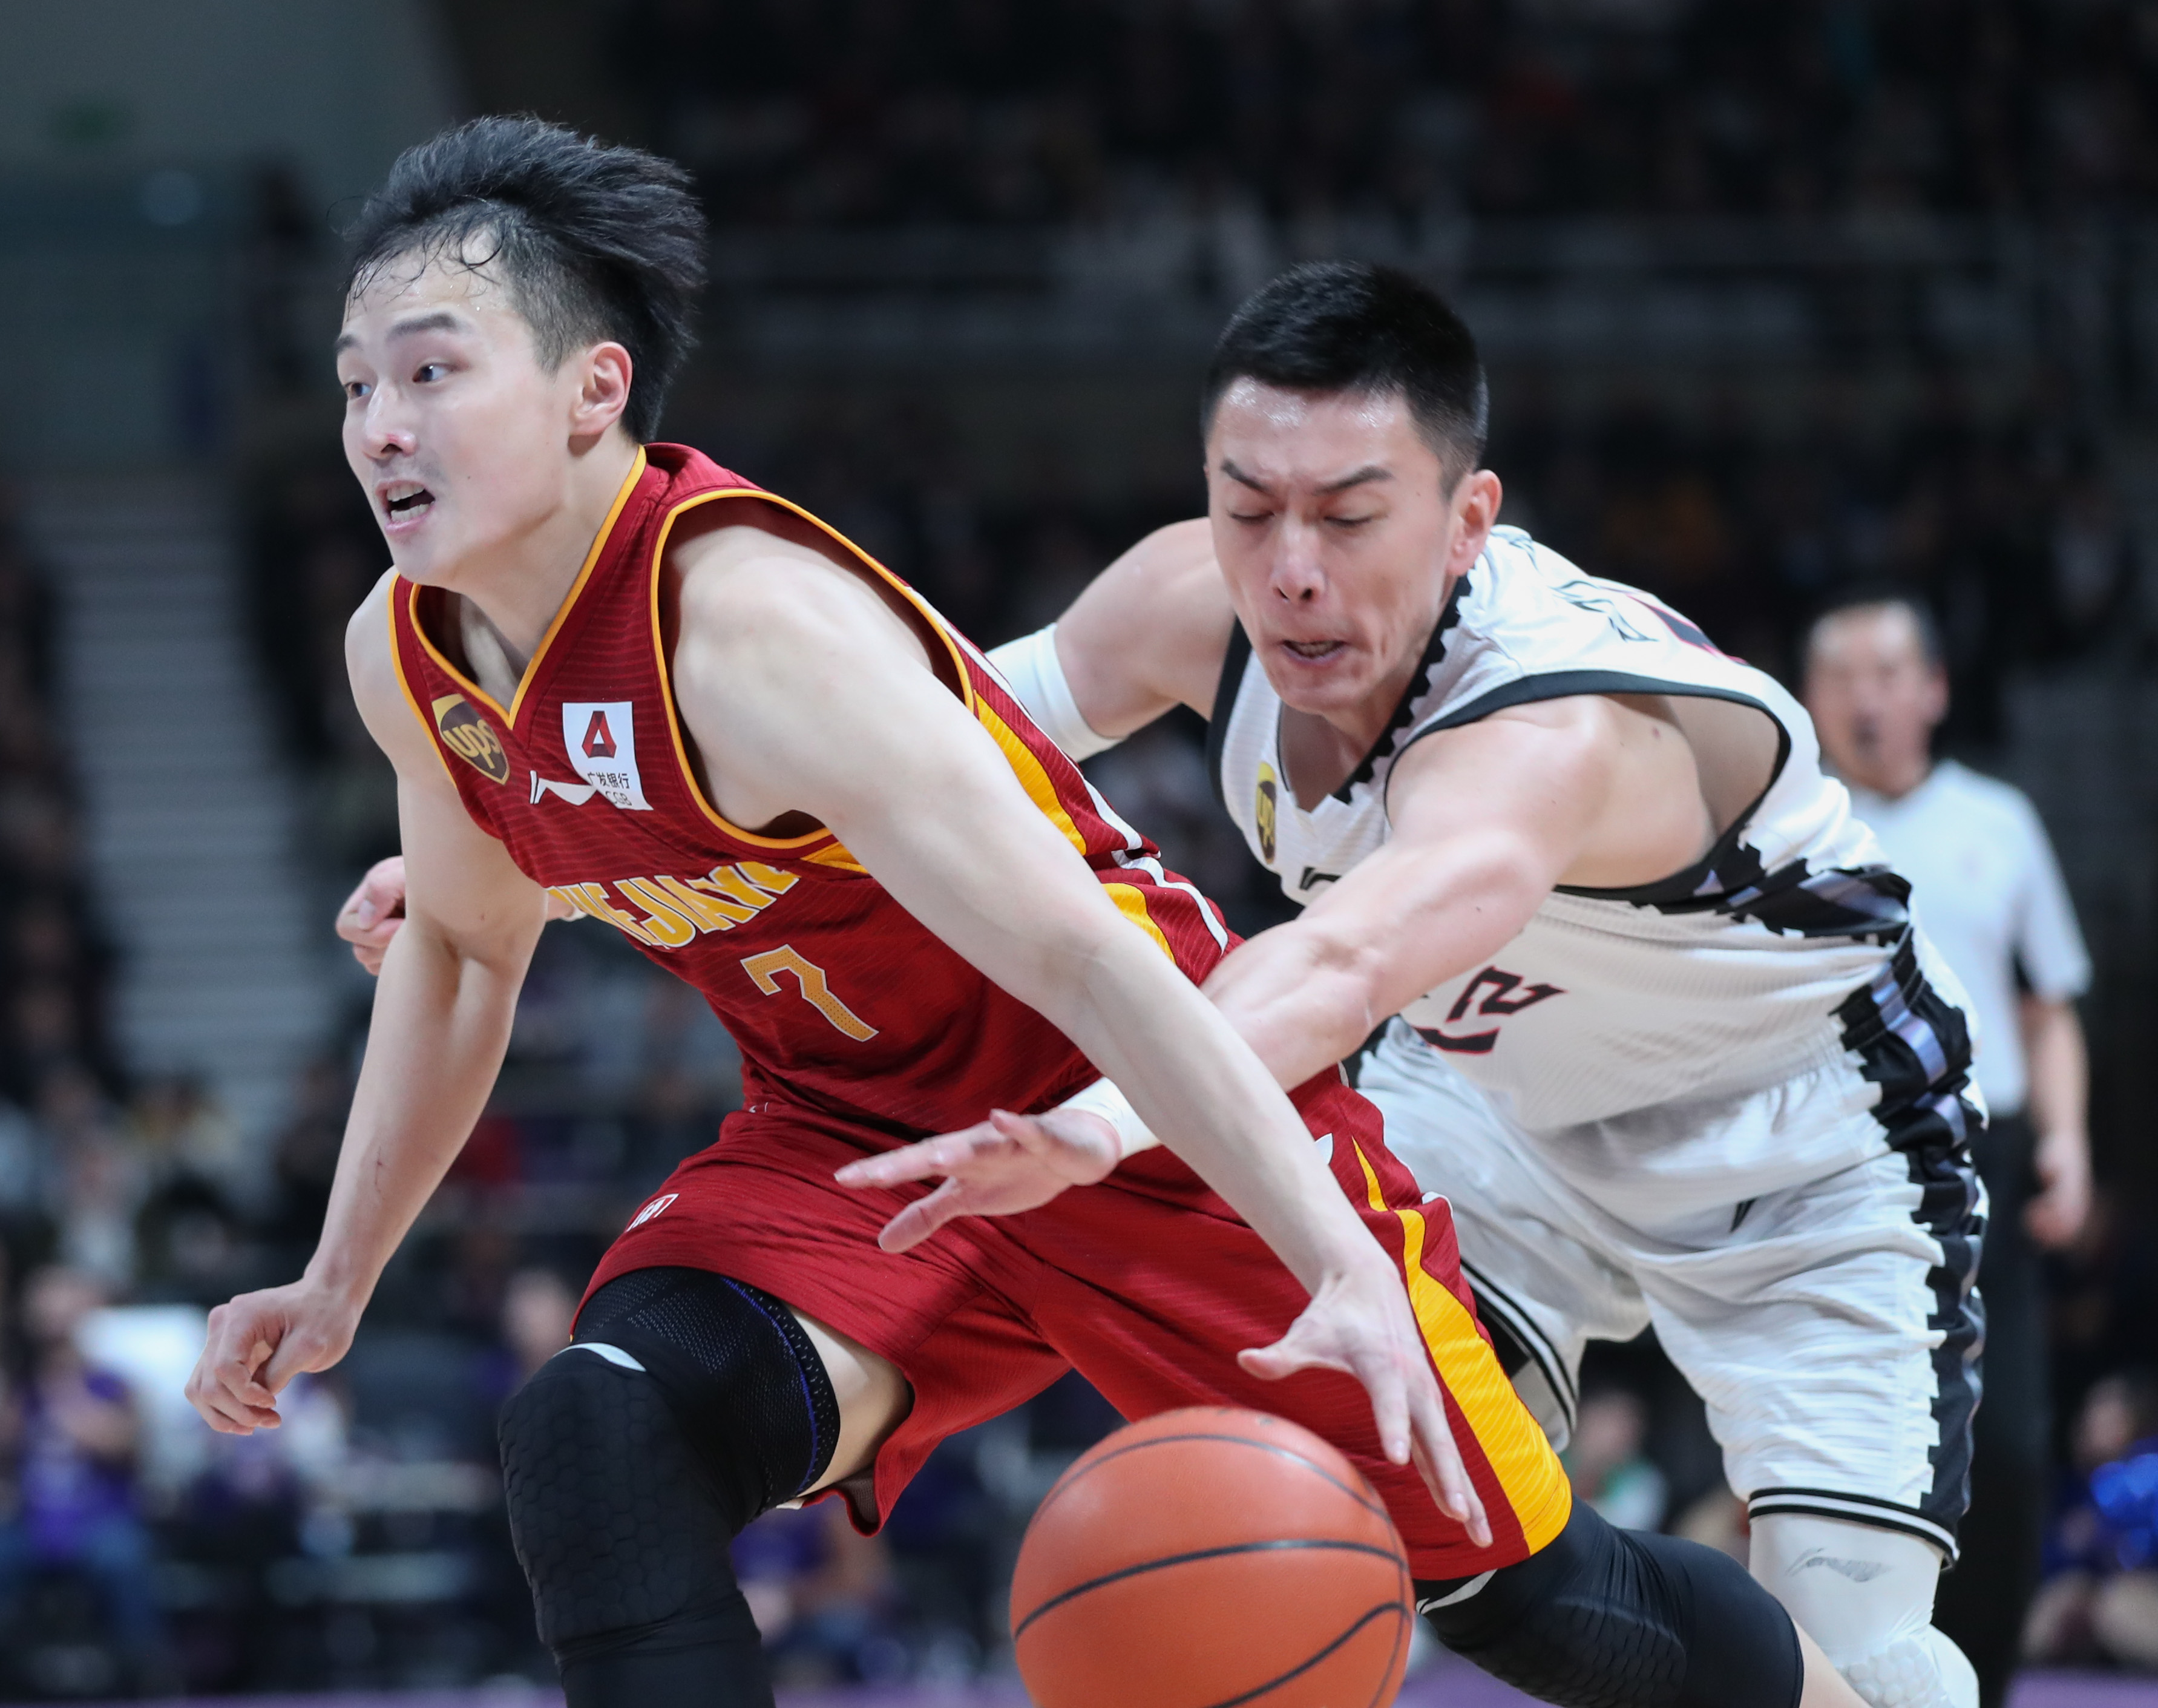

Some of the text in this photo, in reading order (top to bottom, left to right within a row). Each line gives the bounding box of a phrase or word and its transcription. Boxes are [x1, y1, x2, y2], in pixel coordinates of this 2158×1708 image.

[587, 771, 630, 789] 广发银行
[605, 790, 632, 806] CGB
[740, 943, 879, 1043] 7
